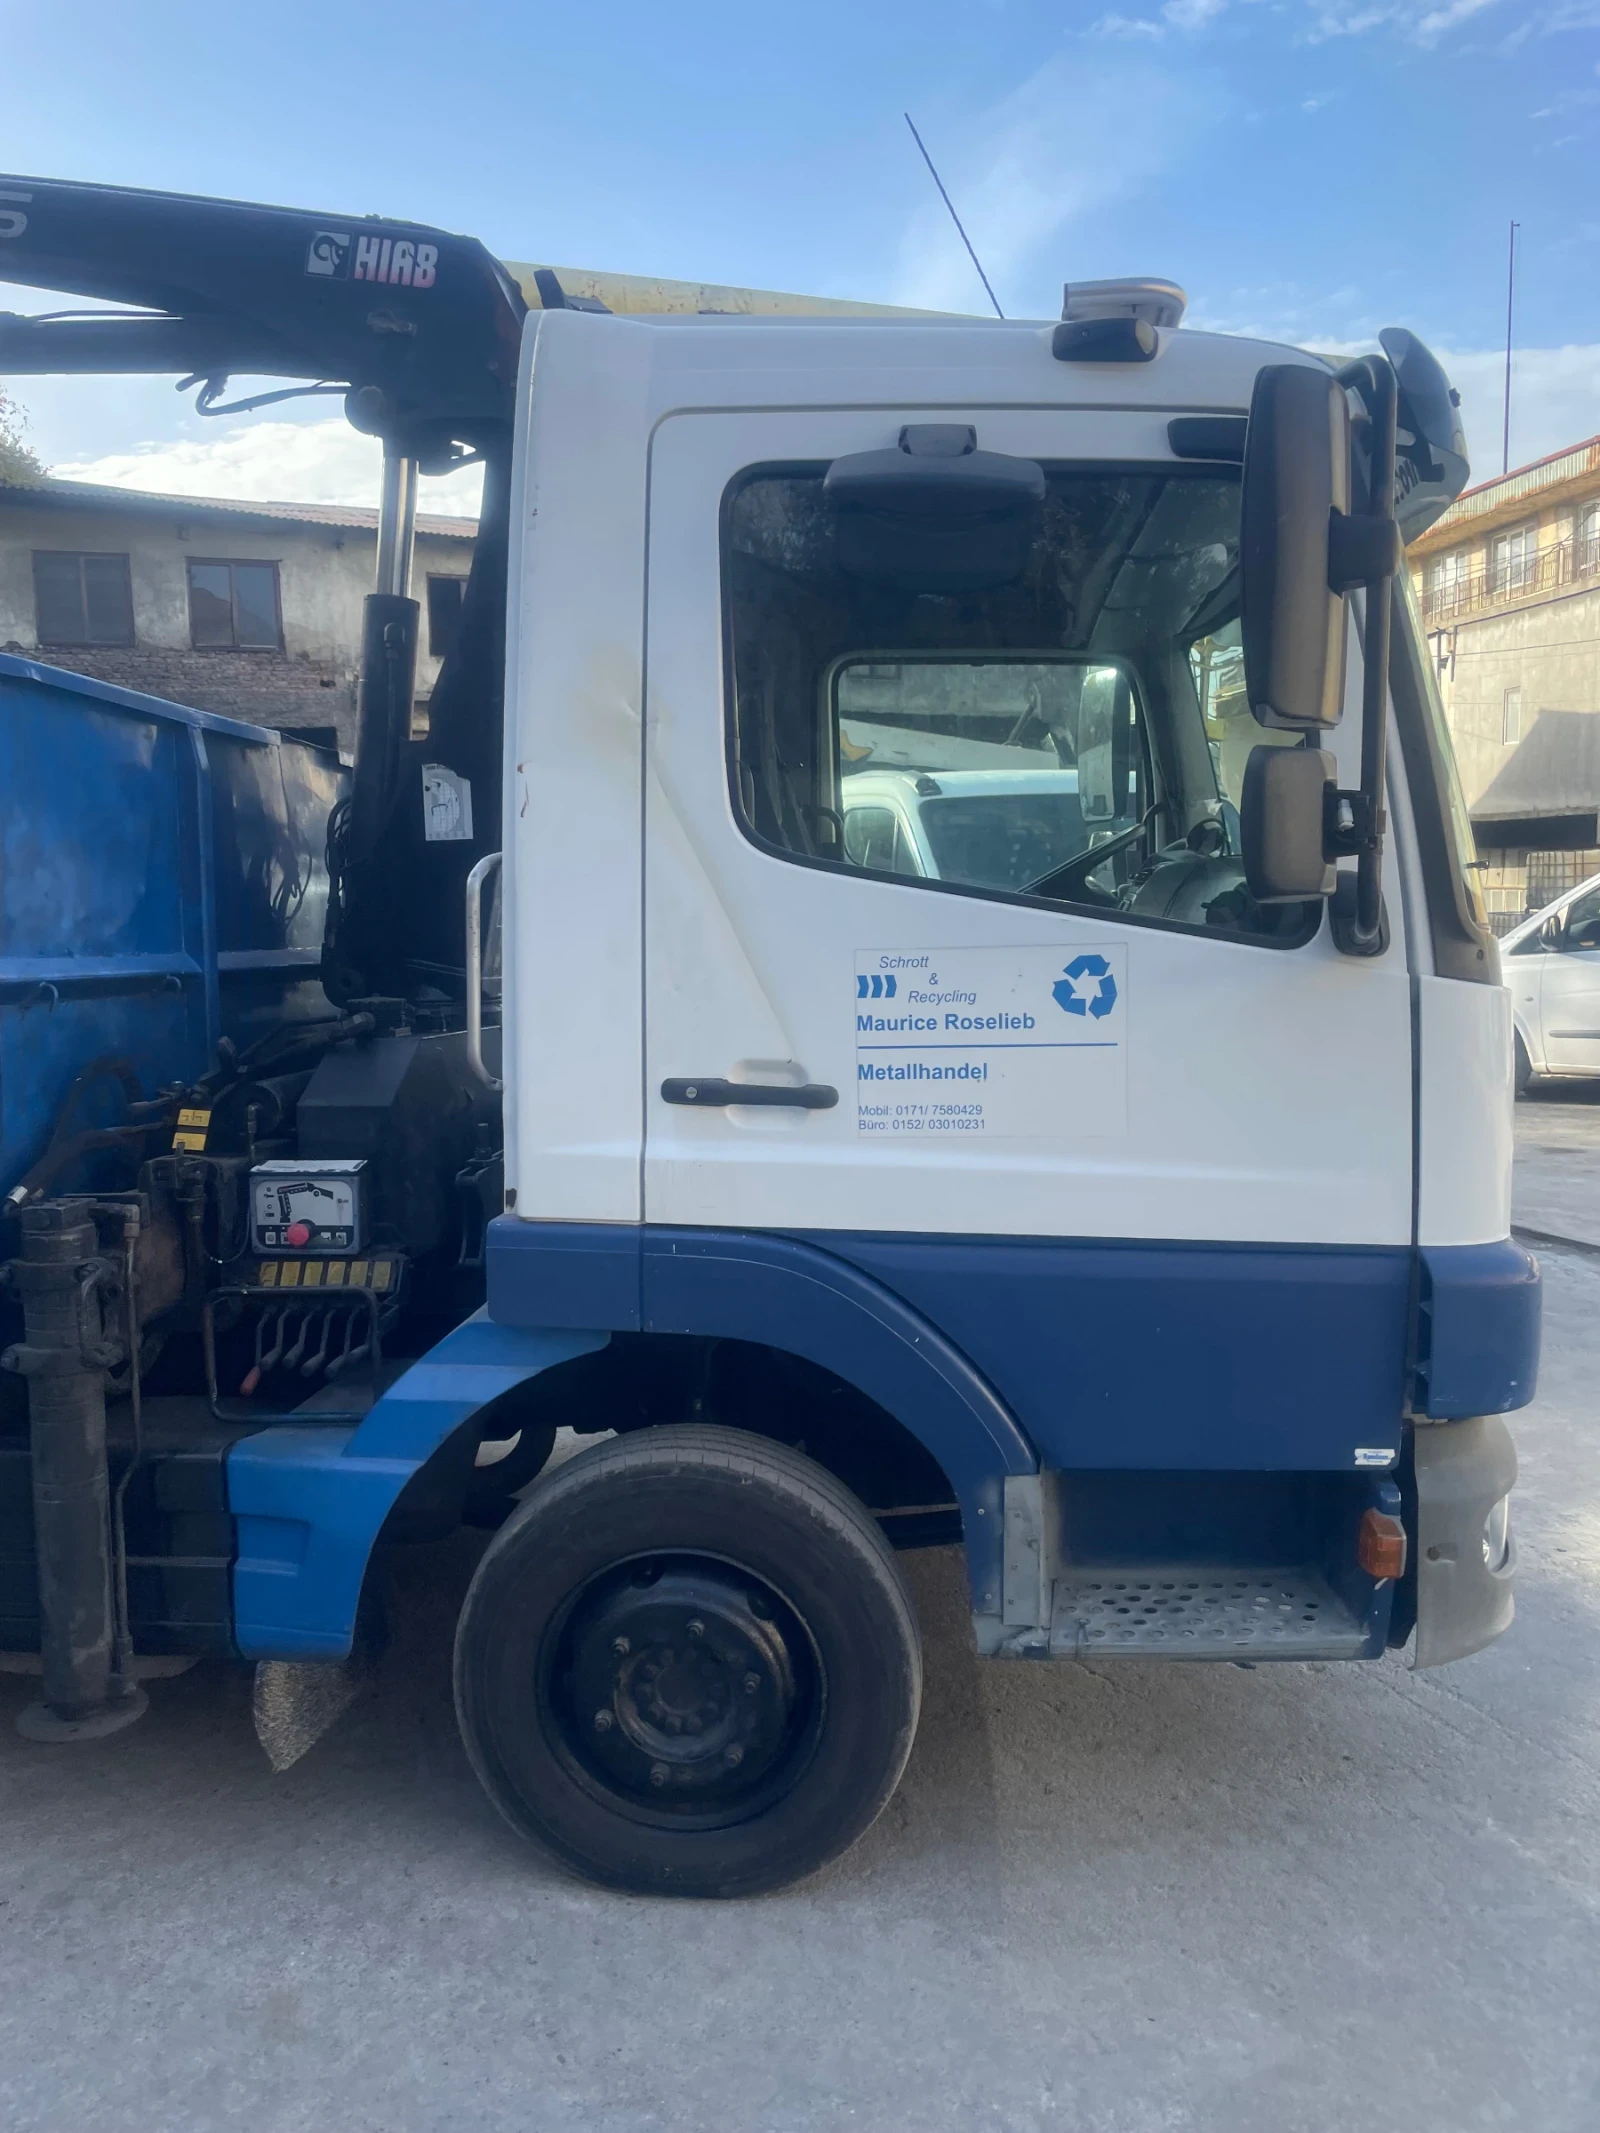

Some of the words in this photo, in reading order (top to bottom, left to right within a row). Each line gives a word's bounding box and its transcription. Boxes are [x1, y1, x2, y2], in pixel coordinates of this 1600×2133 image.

[354, 236, 439, 289] HIAB
[879, 956, 929, 969] Schrott
[929, 972, 939, 986] &
[908, 991, 977, 1005] Recycling
[857, 1015, 937, 1031] Maurice
[944, 1013, 1036, 1030] Roselieb
[858, 1063, 988, 1081] Metallhandel
[858, 1105, 892, 1117] Mobil:
[895, 1105, 928, 1117] 0171/
[932, 1104, 983, 1117] 7580429
[858, 1119, 889, 1131] Büro:
[892, 1119, 925, 1131] 0152/
[928, 1119, 985, 1131] 03010231
